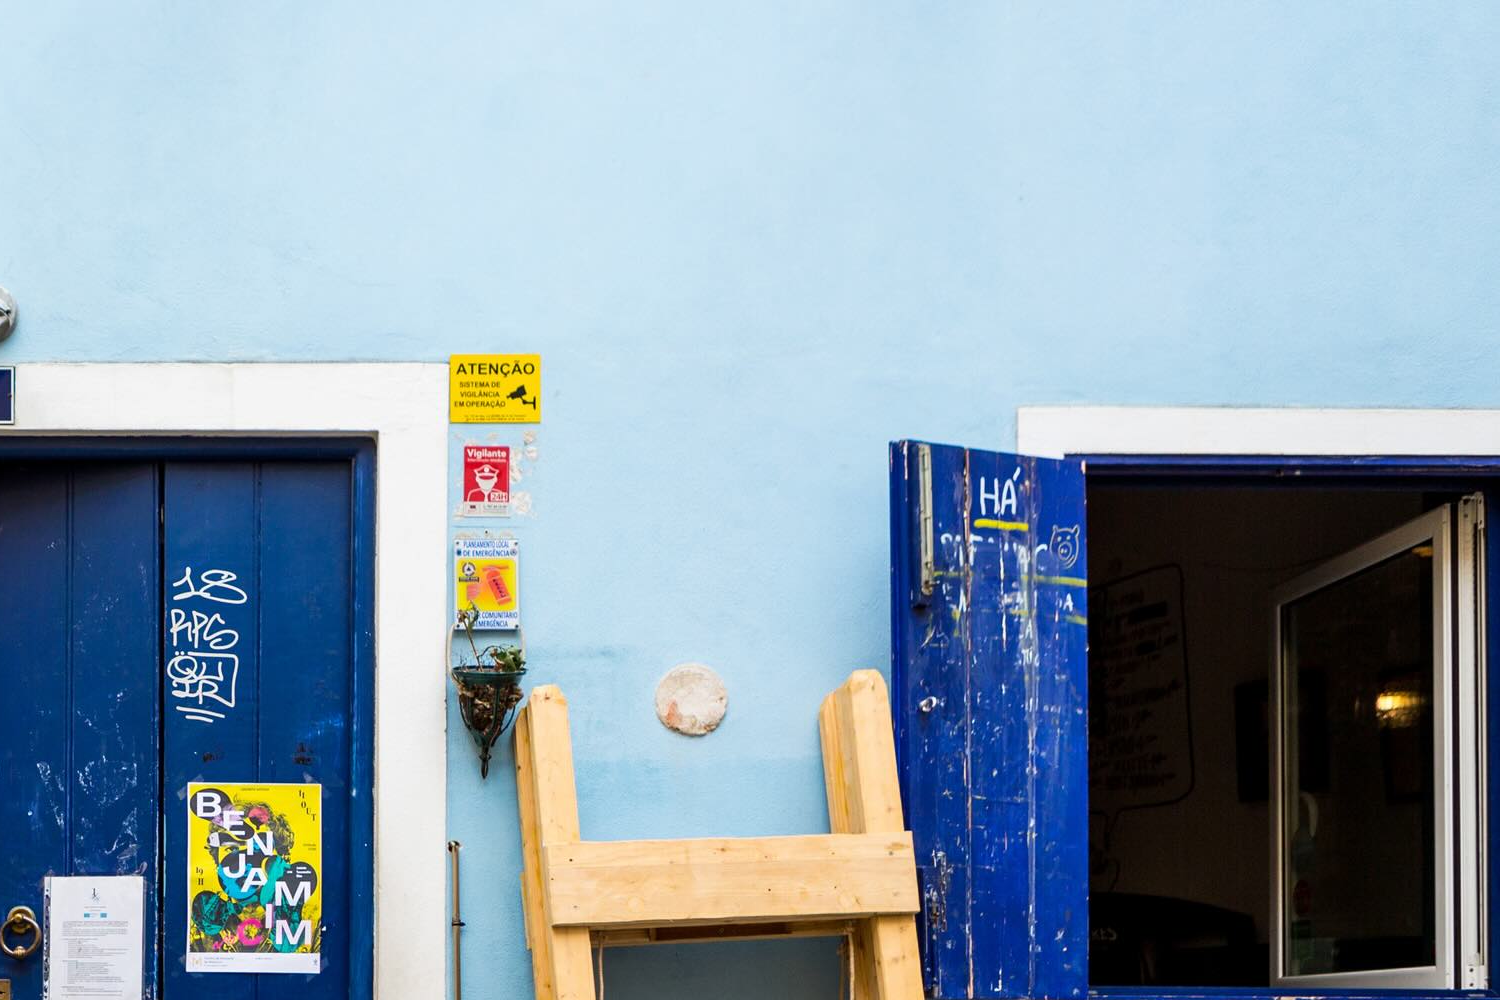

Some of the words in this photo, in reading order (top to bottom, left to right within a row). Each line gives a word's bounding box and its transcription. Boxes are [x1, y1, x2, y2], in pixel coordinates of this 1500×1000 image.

[456, 360, 536, 378] ATENÇÃO
[460, 389, 500, 398] VIGILÂNCIA
[454, 400, 465, 408] EM
[466, 400, 506, 409] OPERAÇÃO
[467, 449, 507, 459] Vigilante
[980, 466, 1022, 516] HÁ
[496, 541, 509, 549] LOCAL
[473, 549, 509, 557] EMERGÊNCIA
[172, 566, 248, 605] 18
